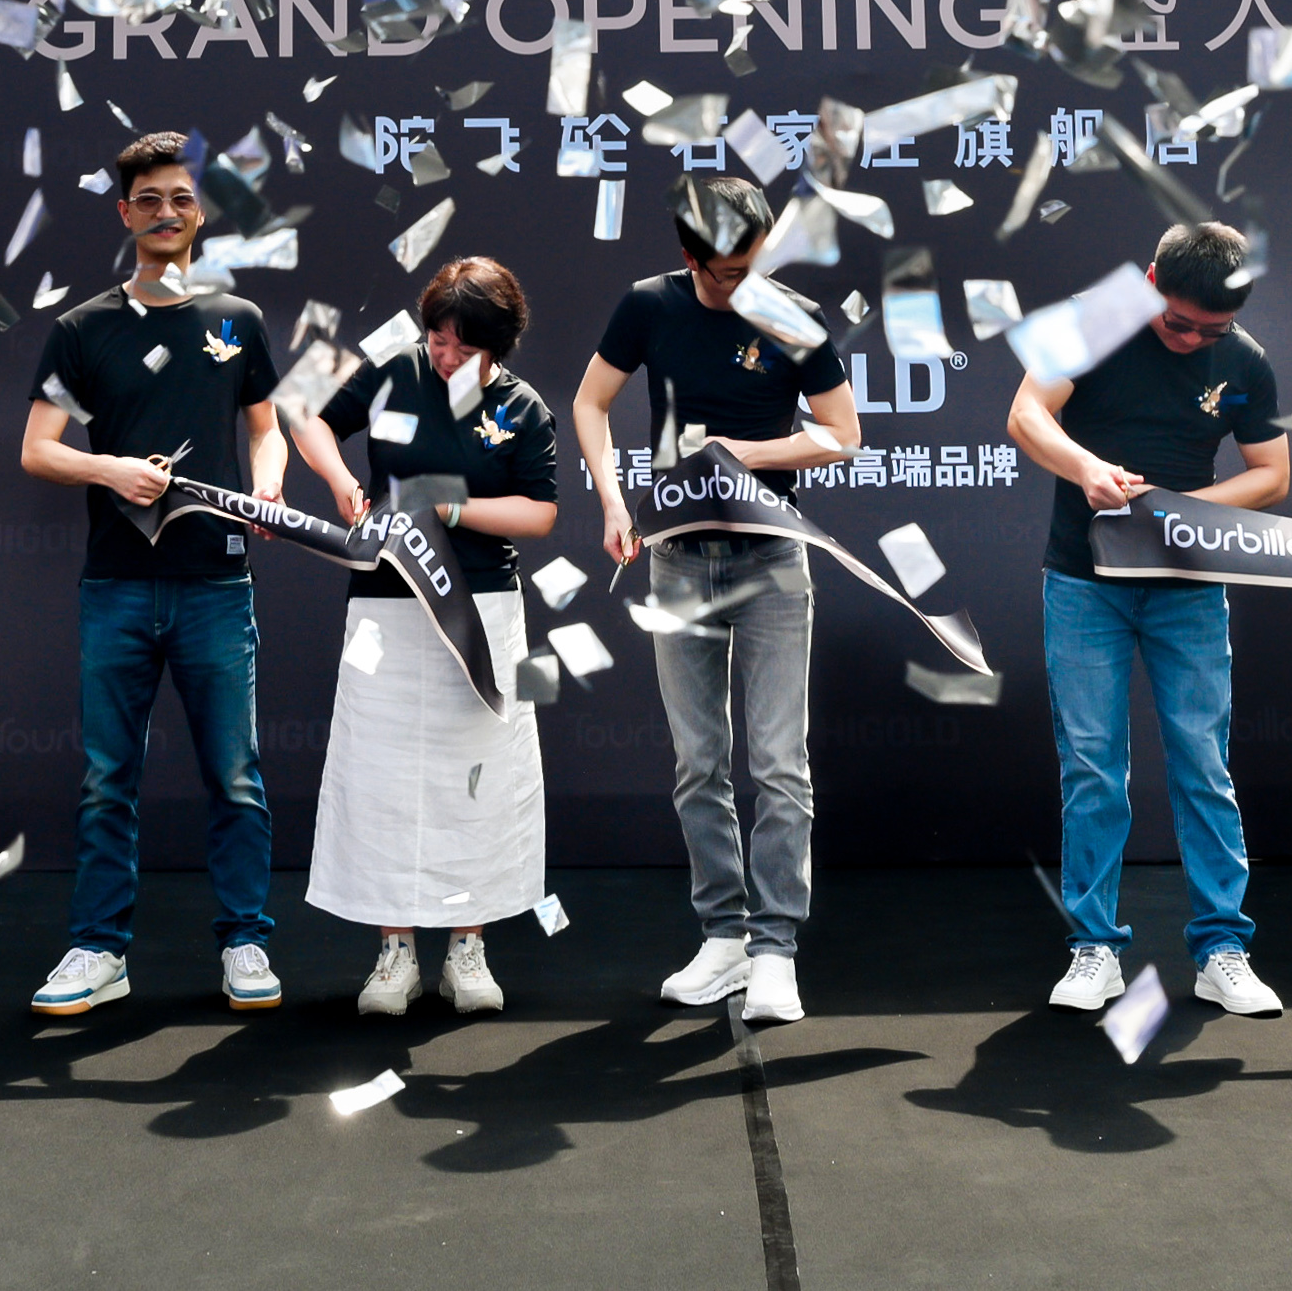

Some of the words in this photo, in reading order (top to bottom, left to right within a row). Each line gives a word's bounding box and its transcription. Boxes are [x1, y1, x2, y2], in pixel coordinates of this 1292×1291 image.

[796, 444, 1019, 489] 际高端品牌
[361, 512, 452, 597] HGOLD
